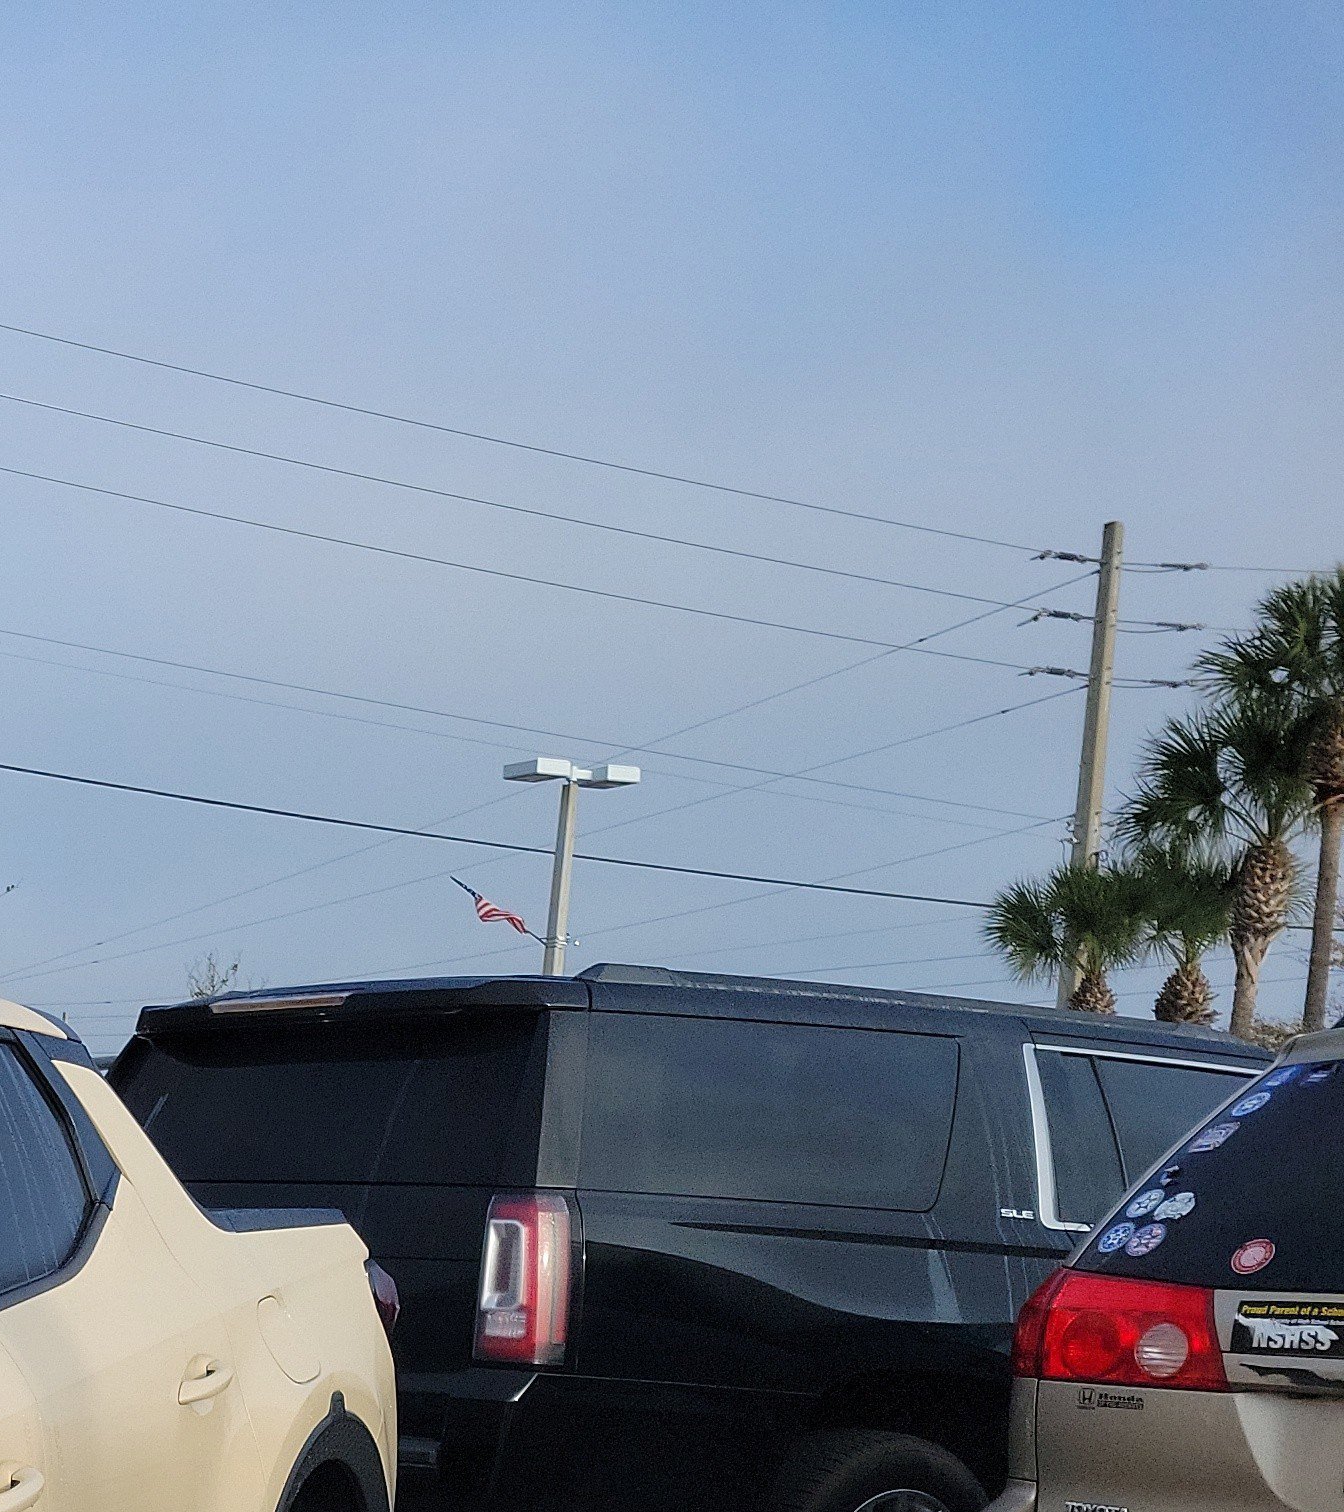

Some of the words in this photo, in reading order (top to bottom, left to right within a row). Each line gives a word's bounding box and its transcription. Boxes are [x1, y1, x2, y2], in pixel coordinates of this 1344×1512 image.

[1000, 1208, 1034, 1220] SLE
[1241, 1305, 1268, 1314] Proud
[1269, 1305, 1299, 1315] Parent
[1301, 1306, 1312, 1315] of
[1312, 1307, 1318, 1315] a
[1252, 1326, 1332, 1351] NSHSS
[1099, 1393, 1143, 1403] Honda
